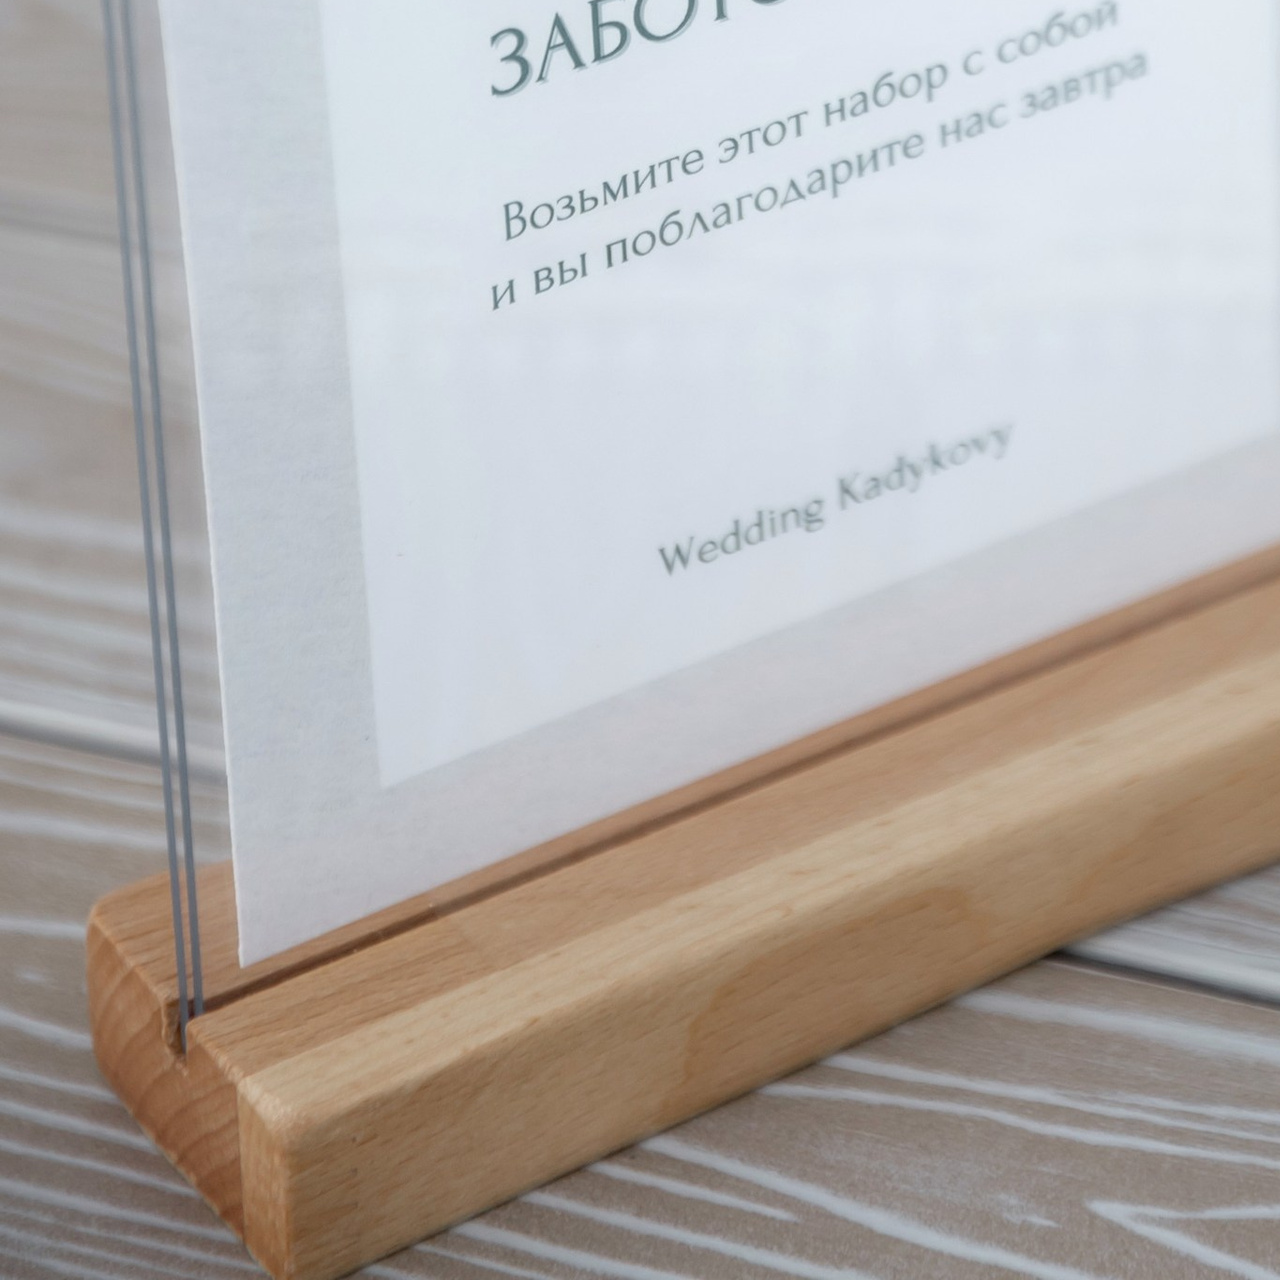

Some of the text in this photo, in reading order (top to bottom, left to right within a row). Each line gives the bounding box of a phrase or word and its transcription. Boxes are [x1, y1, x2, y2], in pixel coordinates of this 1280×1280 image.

[491, 49, 1150, 311] и вы поблагодарите нас завтра
[503, 149, 704, 241] Возьмите
[718, 111, 808, 164] этот
[824, 63, 948, 127] набор
[960, 44, 986, 78] с
[656, 423, 1014, 578] Wedding Kadykovy
